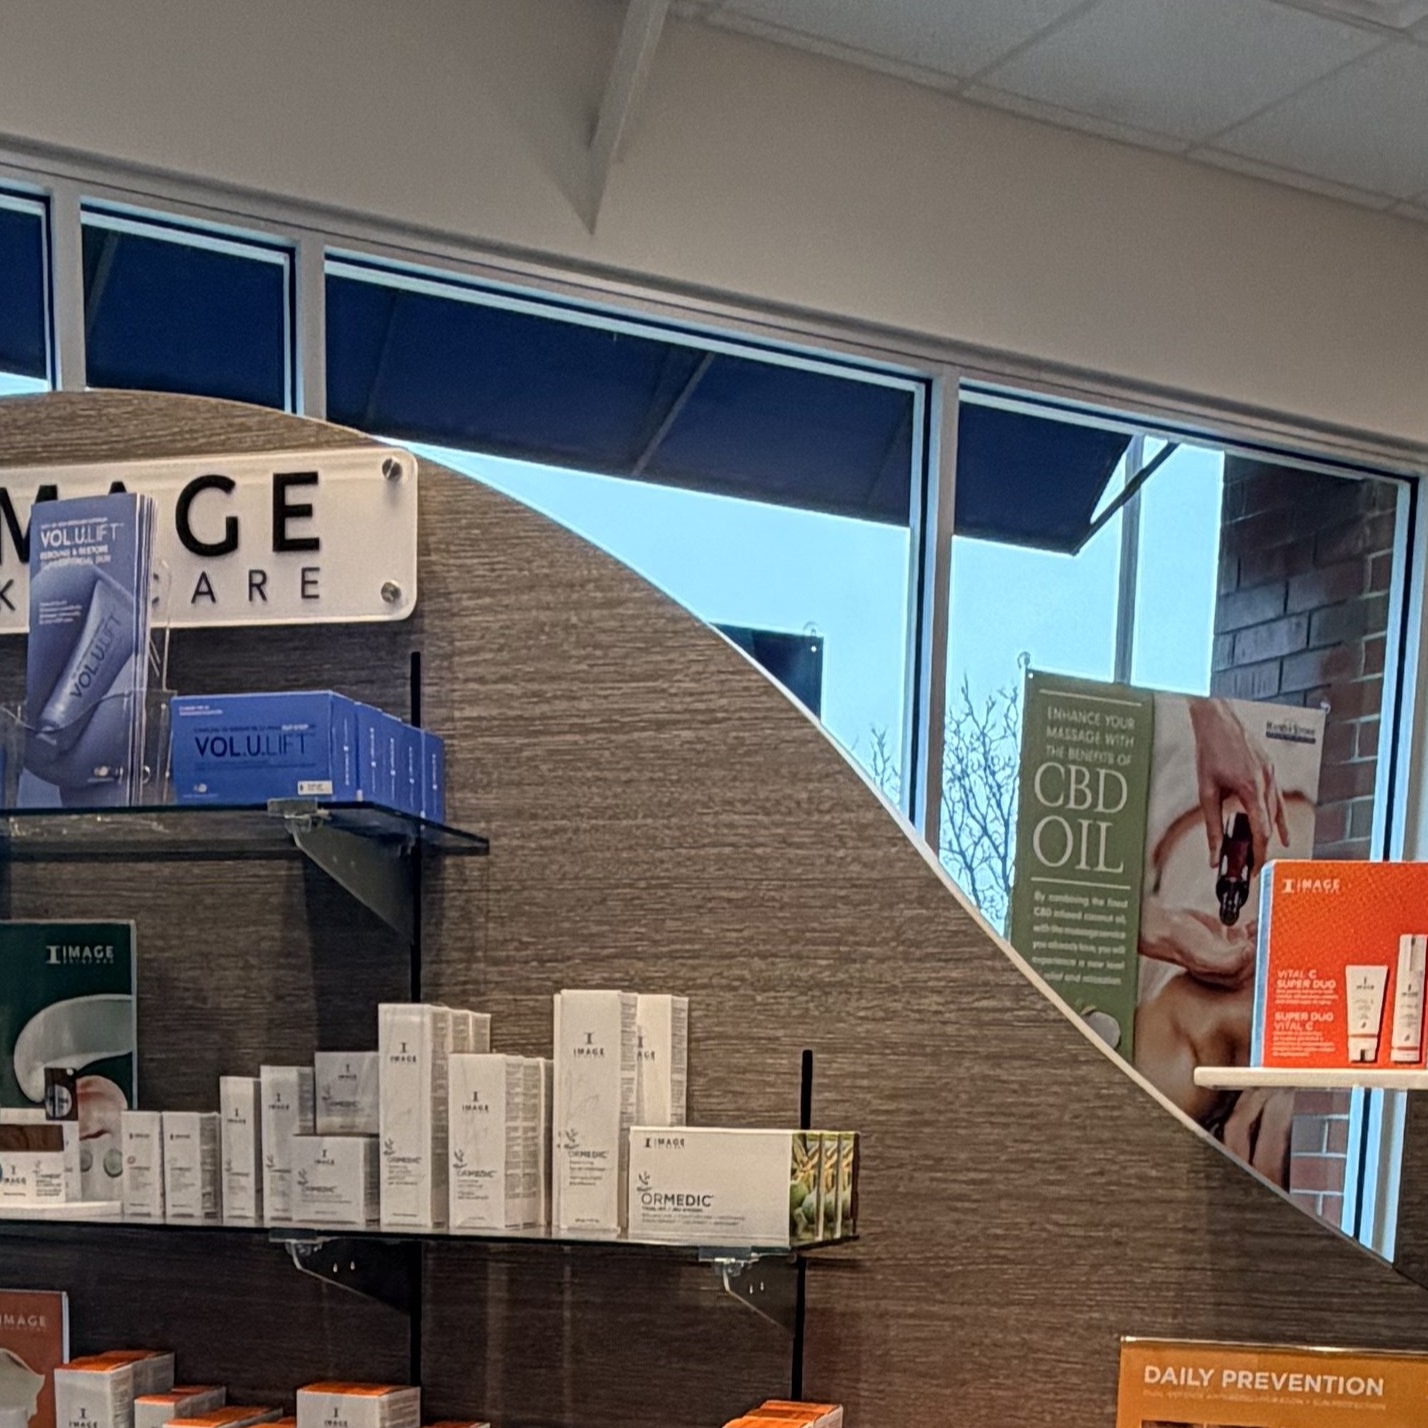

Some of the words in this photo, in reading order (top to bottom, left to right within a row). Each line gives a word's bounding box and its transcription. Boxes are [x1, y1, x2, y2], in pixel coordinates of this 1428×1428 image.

[1047, 706, 1102, 727] ENHANCE
[1104, 714, 1136, 731] YOUR
[1046, 726, 1101, 745] MASSAGE
[1104, 733, 1135, 749] WITH
[1034, 761, 1128, 814] CBD
[1032, 815, 1125, 873] OIL
[1297, 878, 1341, 890] IMAGE
[62, 945, 114, 959] IMAGE
[1276, 979, 1311, 989] SUPER
[1312, 979, 1337, 990] DUO
[640, 1192, 713, 1208] ORMEDIC
[1143, 1365, 1214, 1388] DAILY
[1220, 1368, 1386, 1398] PREVENTION
